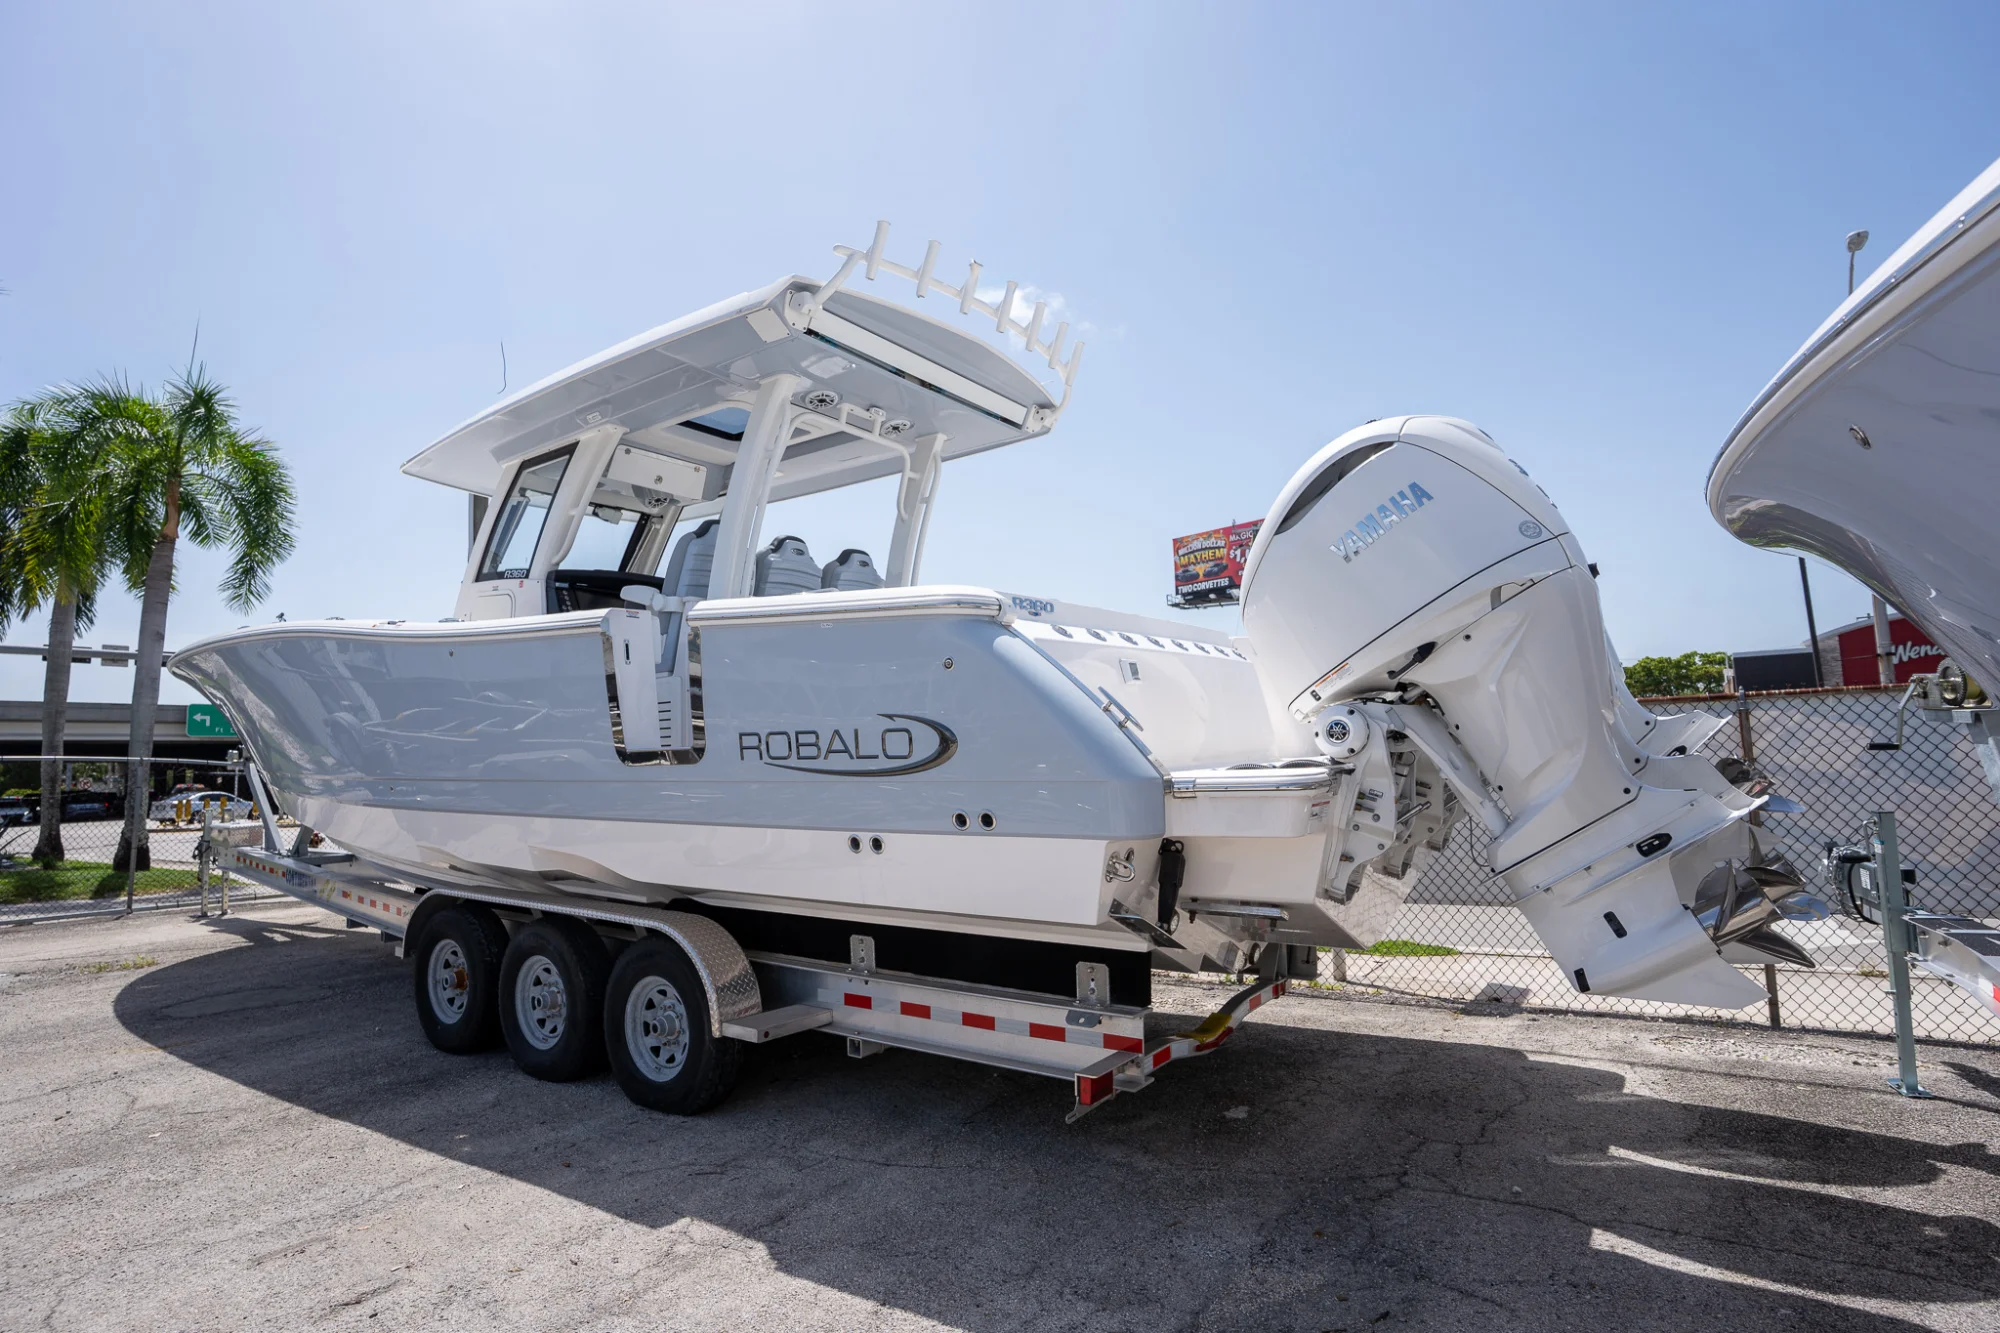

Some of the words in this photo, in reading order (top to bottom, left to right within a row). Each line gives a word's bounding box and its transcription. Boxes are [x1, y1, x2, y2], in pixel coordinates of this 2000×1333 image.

[1329, 481, 1434, 564] YAMAHA
[1201, 539, 1226, 549] DOLLAR
[1180, 548, 1225, 566] MAYHEM
[504, 569, 527, 579] R360
[1178, 584, 1193, 594] TWO
[1193, 577, 1229, 591] CORVETTES
[1012, 596, 1055, 613] R360
[738, 728, 913, 761] ROBALO
